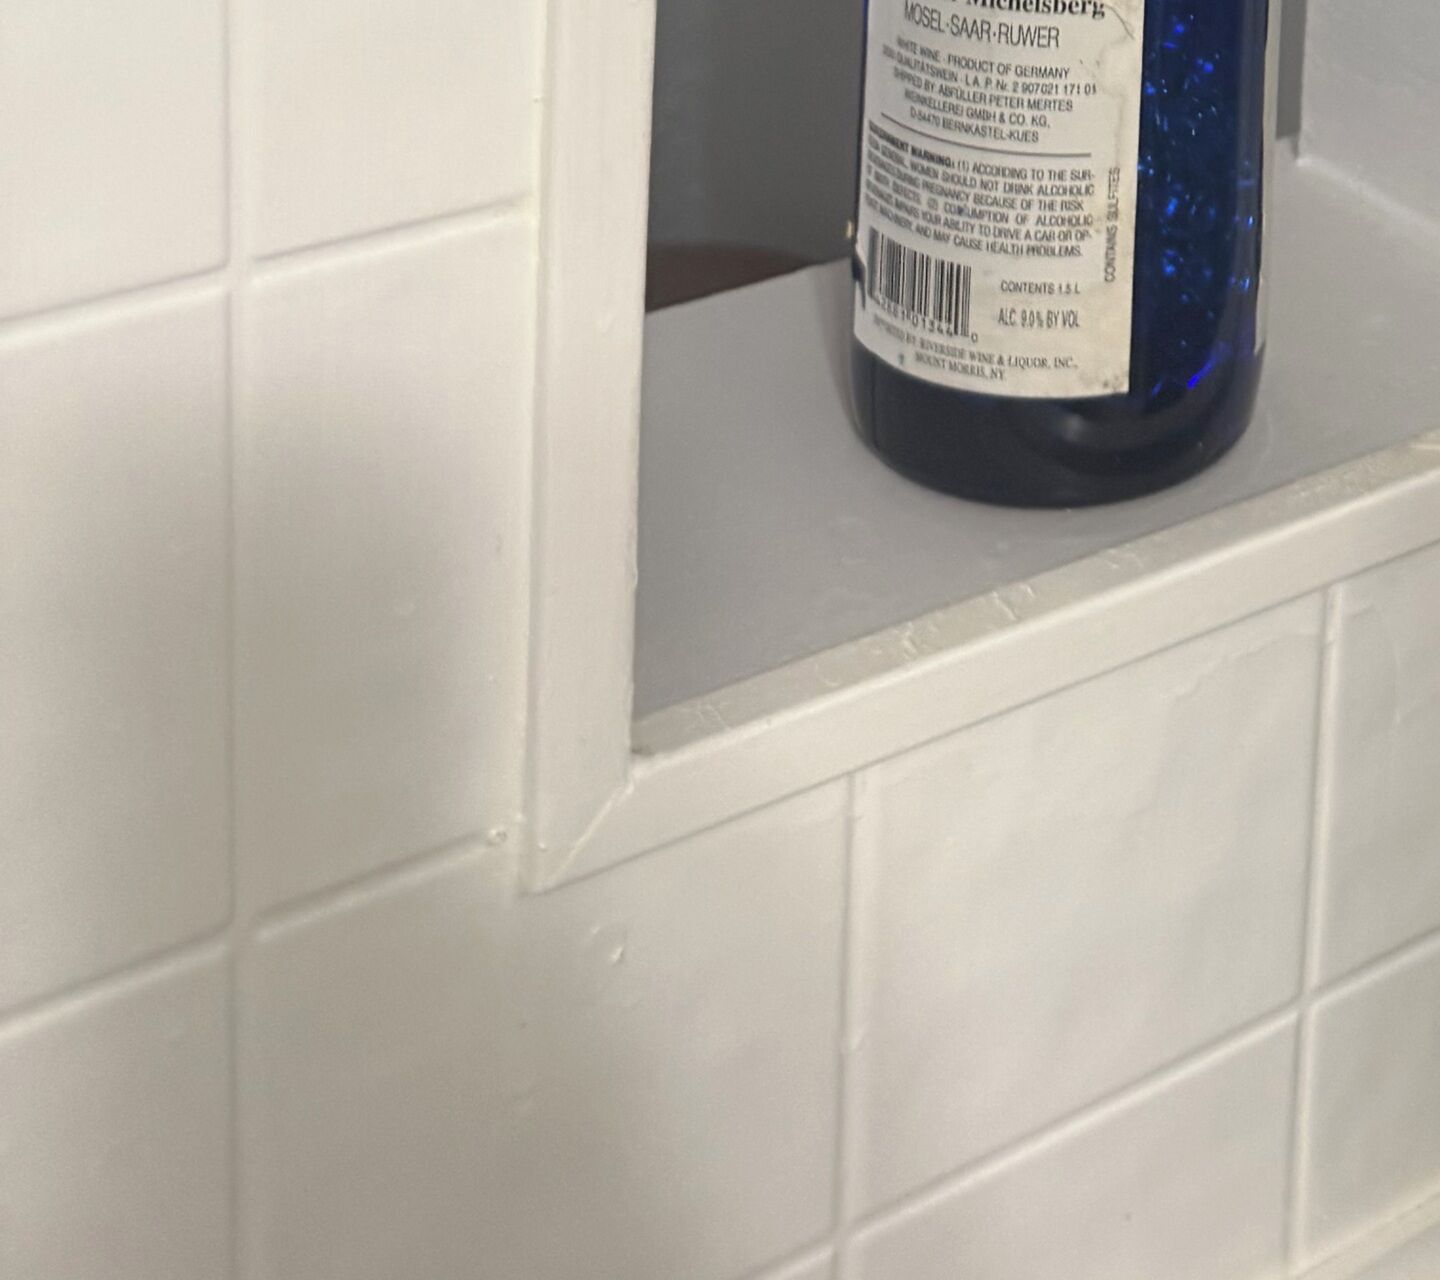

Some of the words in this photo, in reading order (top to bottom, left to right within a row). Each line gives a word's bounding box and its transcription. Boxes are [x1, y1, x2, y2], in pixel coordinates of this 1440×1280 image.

[920, 45, 940, 62] WINE
[948, 53, 994, 73] PRODUCT
[996, 61, 1012, 77] OF
[1015, 64, 1070, 80] GERMANY
[924, 80, 936, 93] BY
[989, 93, 1024, 110] PETER
[1026, 97, 1073, 113] MERTES
[998, 111, 1006, 124] &
[972, 161, 1027, 181] ACCORDING
[1031, 168, 1044, 181] TO
[1047, 169, 1067, 182] THE
[980, 178, 998, 193] NOT
[1003, 180, 1033, 196] DRINK
[1036, 183, 1095, 197] ALCOHOLIC
[973, 192, 1016, 210] BECAUSE
[1020, 198, 1036, 211] OF
[1038, 198, 1057, 212] THE
[1060, 199, 1084, 212] RISK
[1015, 212, 1029, 225] OF
[1035, 213, 1093, 228] ALCOHOLIC
[979, 224, 991, 237] TO
[993, 224, 1020, 241] DRIVE
[1024, 228, 1032, 241] A
[954, 233, 983, 251] CAUSE
[986, 239, 1023, 256] HEALTH
[1000, 279, 1055, 296] CONTENTS
[1074, 281, 1081, 295] L
[1046, 309, 1060, 329] BY
[969, 350, 995, 365] WINE
